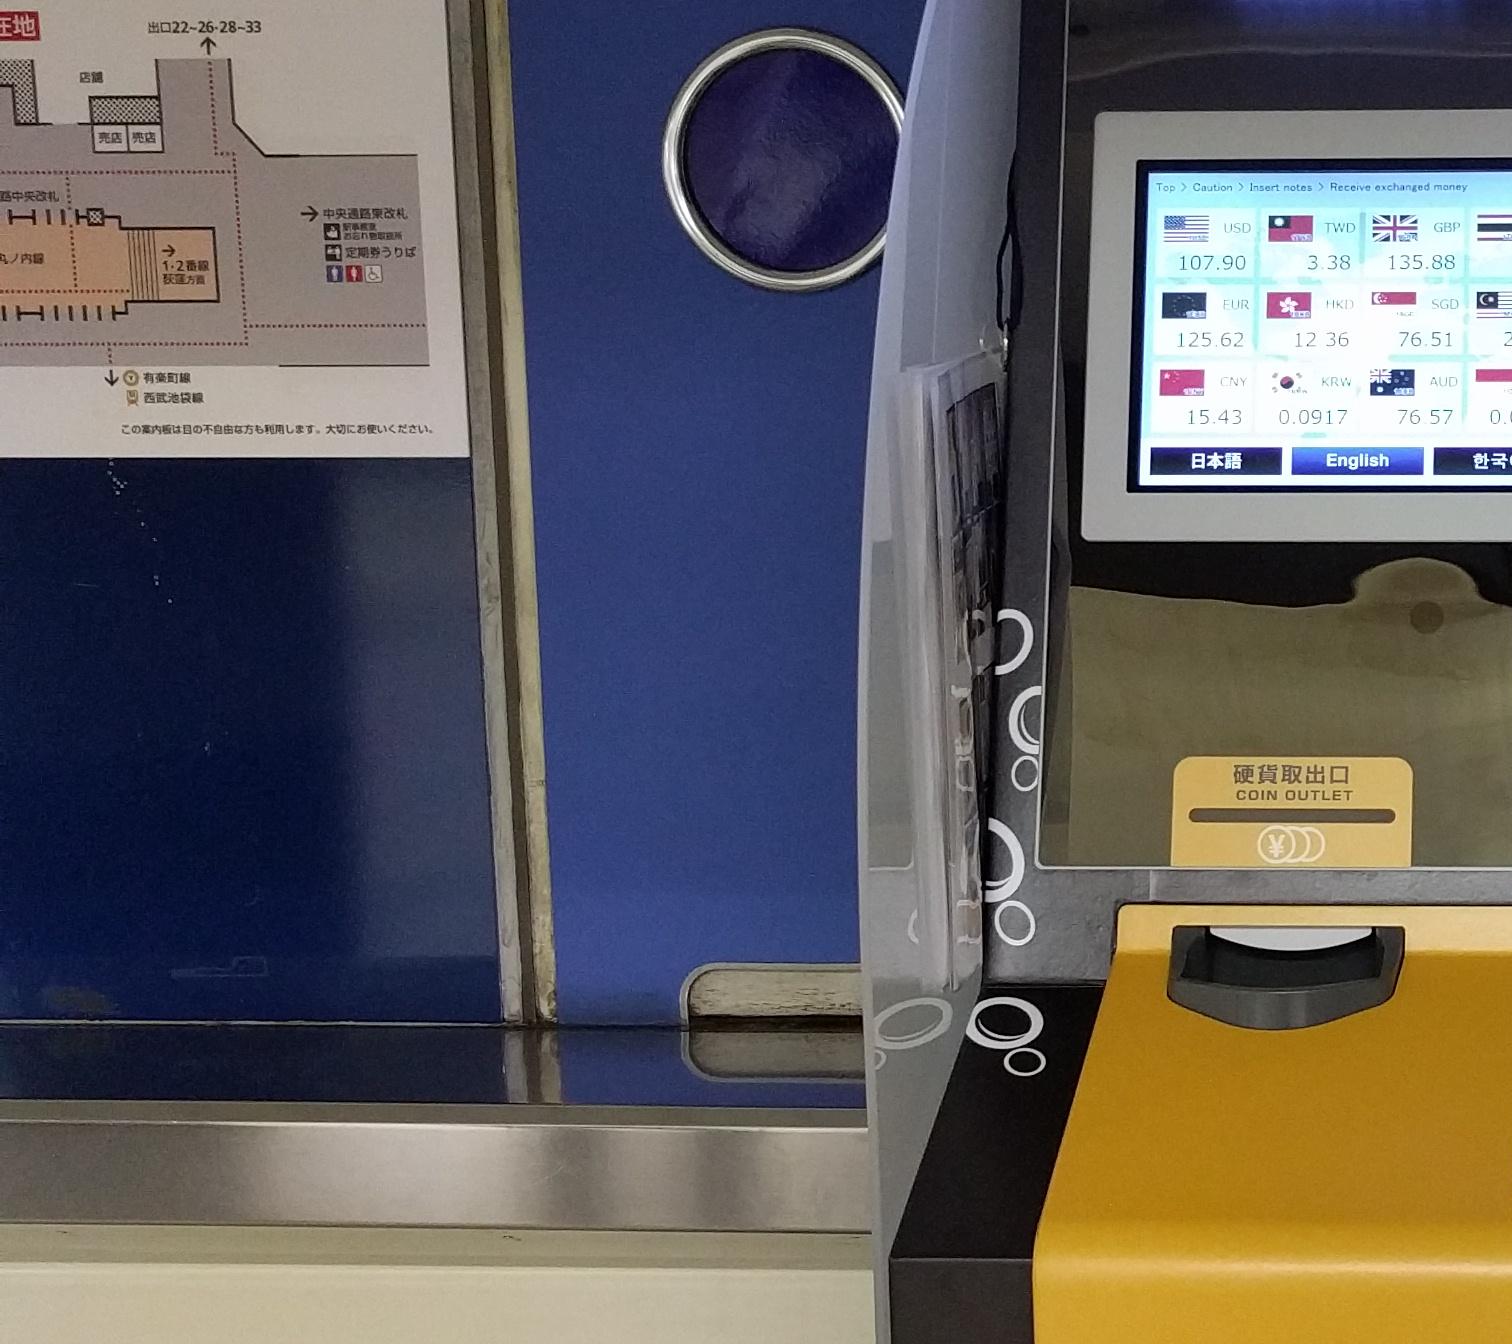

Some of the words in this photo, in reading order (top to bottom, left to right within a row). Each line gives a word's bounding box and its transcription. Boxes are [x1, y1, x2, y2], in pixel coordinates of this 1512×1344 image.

[1156, 182, 1176, 193] Top
[1192, 182, 1233, 193] Caution
[1249, 182, 1281, 192] Insert
[1283, 183, 1313, 192] notes
[1330, 182, 1370, 192] Receive
[1374, 181, 1431, 193] exchanged
[1433, 184, 1468, 194] money
[1223, 222, 1252, 234] USD
[1324, 222, 1356, 234] TWD
[1433, 221, 1461, 233] GBP
[1178, 254, 1247, 271] 107.90
[1307, 254, 1351, 271] 3.38
[1387, 254, 1456, 270] 135.88
[1222, 299, 1250, 311] EUR
[1431, 298, 1460, 311] SGD
[1177, 331, 1245, 348] 125.62
[1398, 331, 1453, 348] 76.51
[1219, 376, 1248, 388] CNY
[1321, 376, 1352, 387] KRW
[1429, 376, 1459, 388] AUD
[1187, 409, 1243, 425] 15.43
[1278, 409, 1349, 425] 0.0917
[1397, 409, 1454, 425] 76.57
[1190, 450, 1243, 471] 日本語
[1325, 450, 1391, 471] English
[1232, 763, 1349, 785] 硬貨取出口
[1235, 789, 1278, 801] COIN
[1285, 789, 1354, 801] OUTLET
